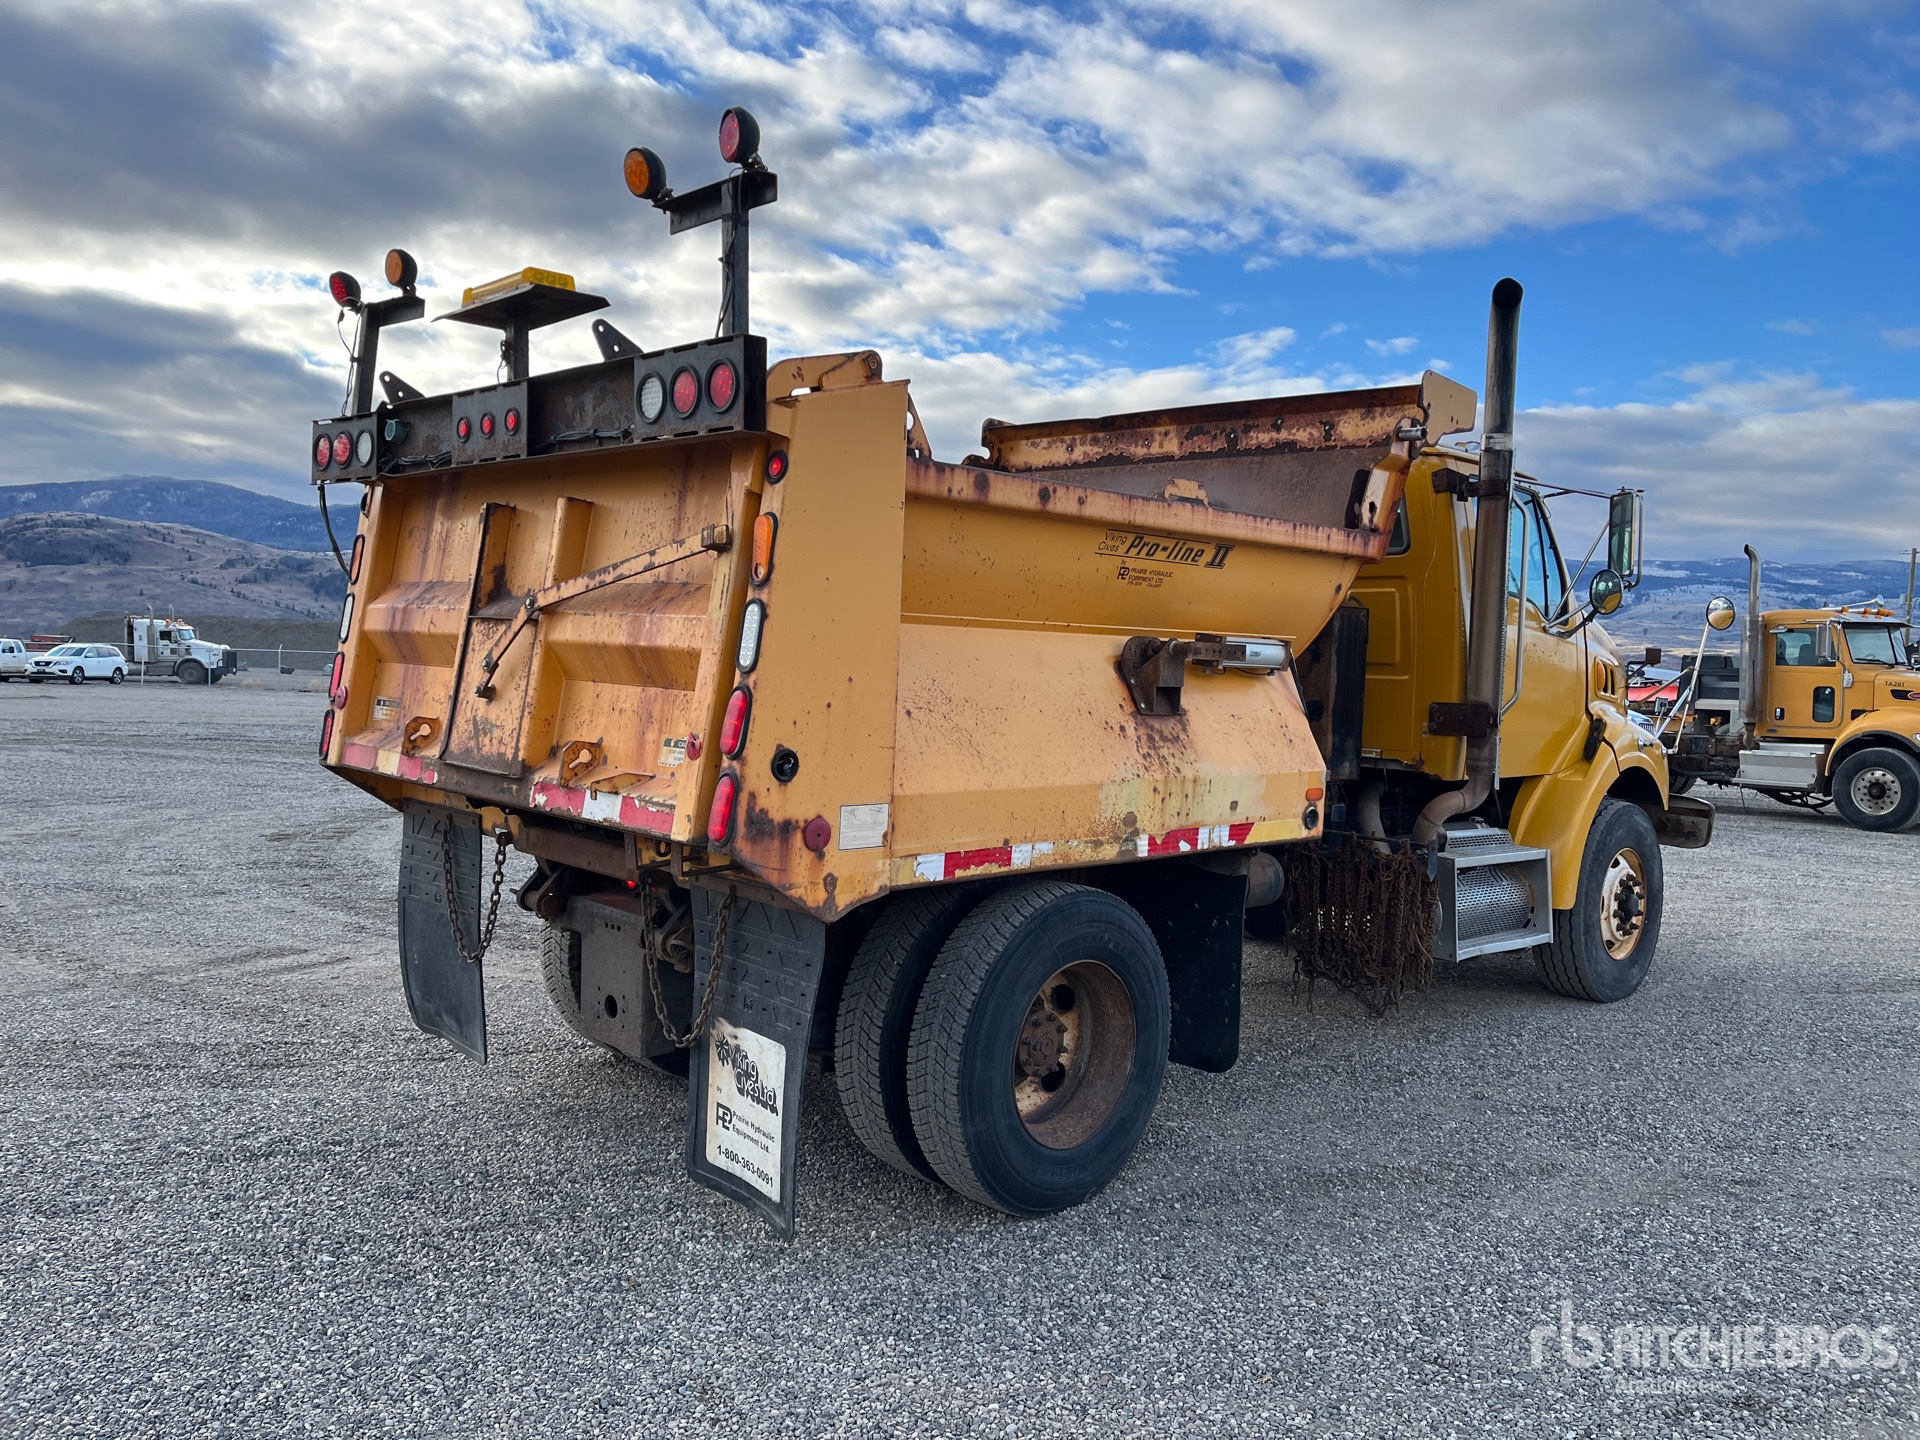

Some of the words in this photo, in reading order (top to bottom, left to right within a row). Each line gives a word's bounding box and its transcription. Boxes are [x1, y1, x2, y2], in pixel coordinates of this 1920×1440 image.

[1098, 541, 1120, 553] Cives
[1105, 532, 1128, 546] Viking
[1123, 535, 1205, 563] Pro-line
[1128, 575, 1154, 583] EQUIPMENT
[1131, 567, 1148, 575] PRAIRIE
[1149, 570, 1174, 578] HYDRAULIC
[728, 1043, 758, 1081] Viking
[716, 1085, 722, 1094] by
[732, 1110, 749, 1127] Prairie
[750, 1121, 775, 1143] Hydraulic
[732, 1124, 760, 1148] Equipment
[760, 1141, 771, 1154] Ltd.
[716, 1144, 773, 1188] 1-800-363-0091
